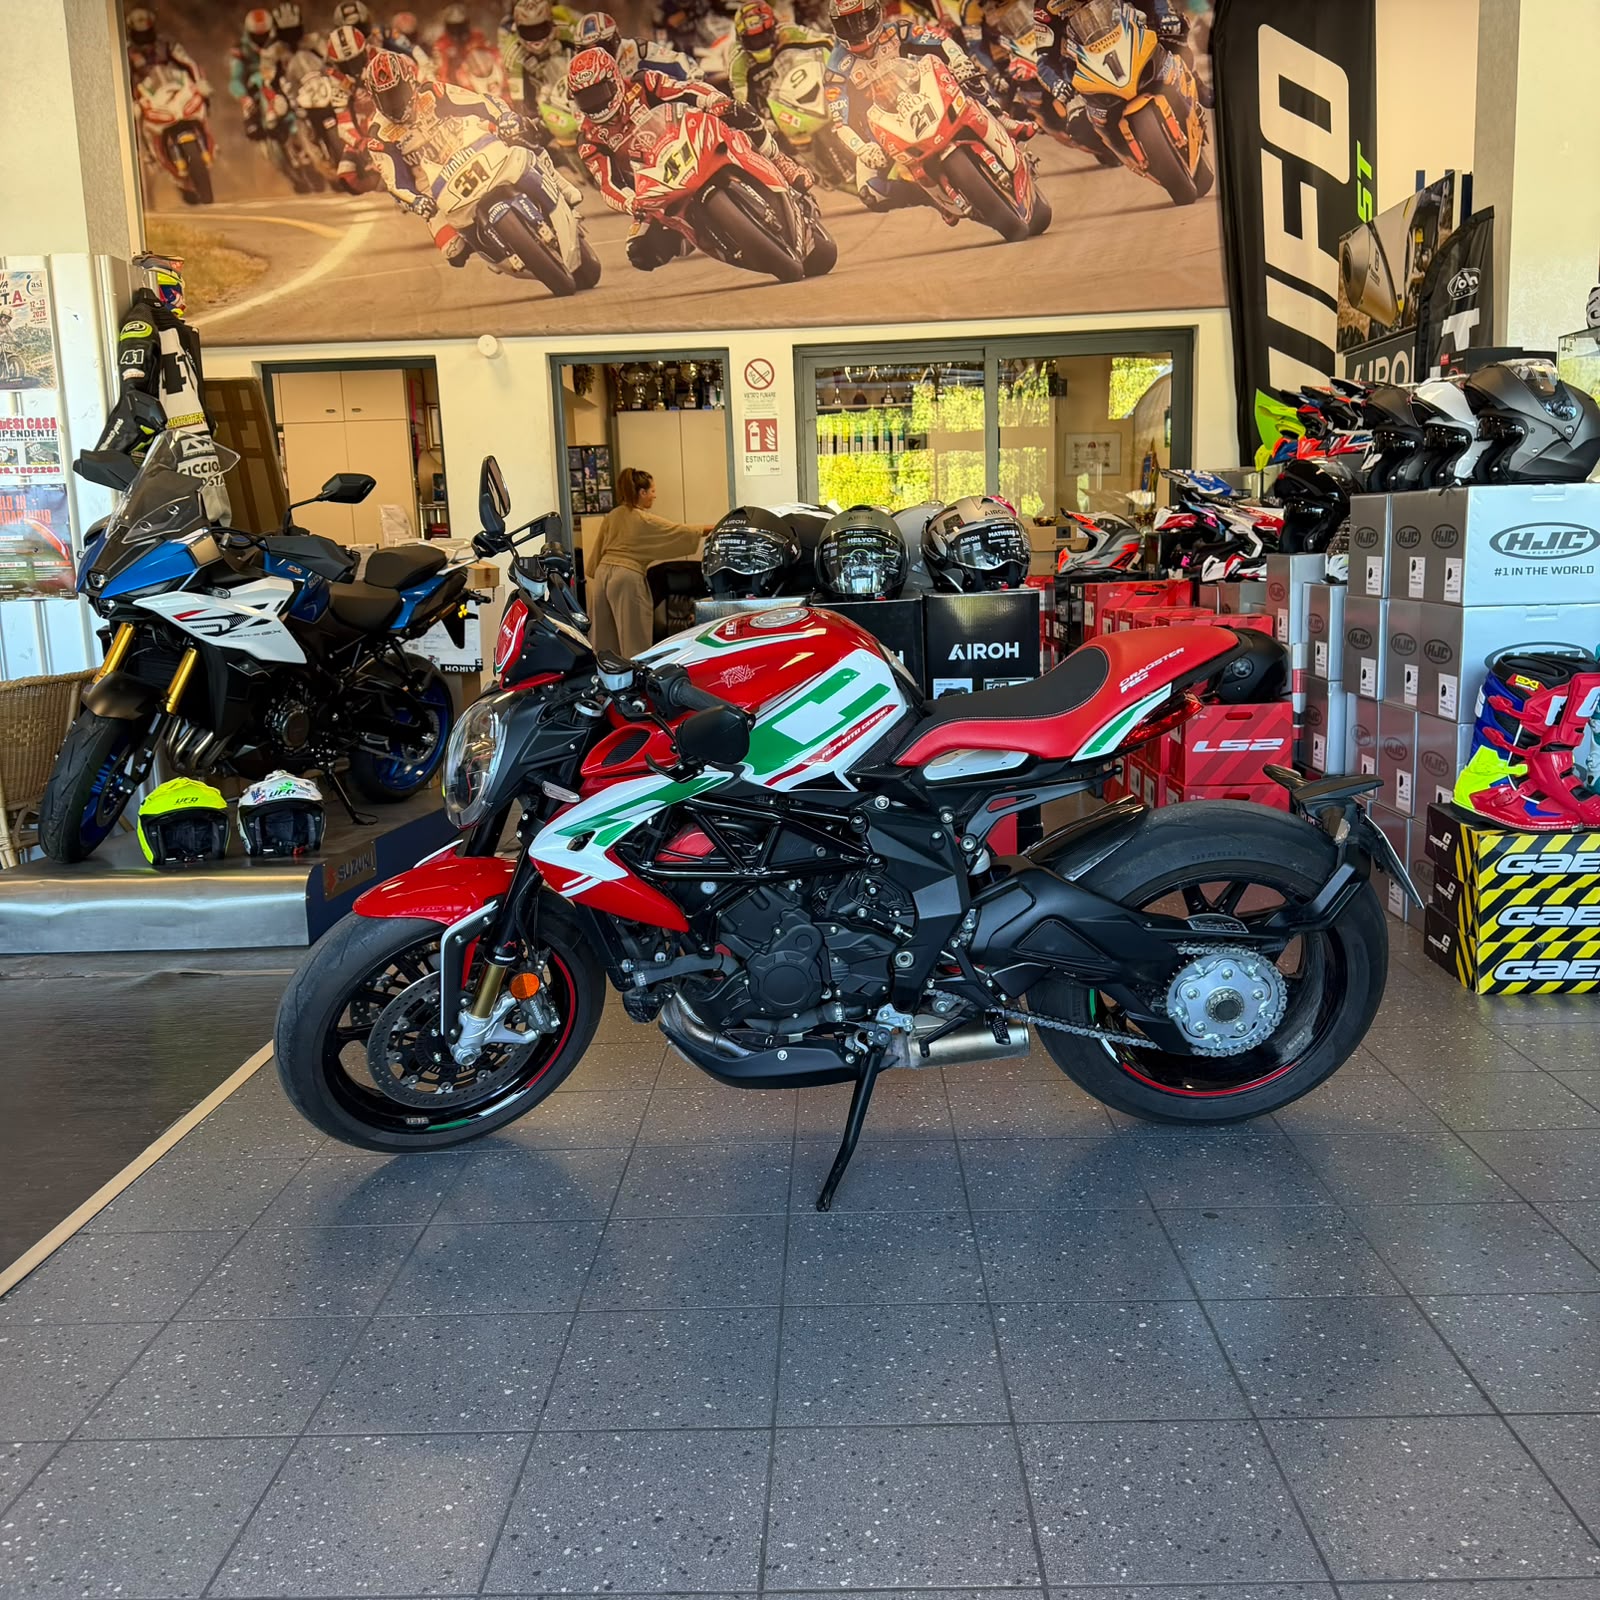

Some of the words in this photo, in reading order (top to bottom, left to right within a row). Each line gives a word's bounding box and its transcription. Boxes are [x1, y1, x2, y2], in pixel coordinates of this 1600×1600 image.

[1102, 49, 1126, 82] 1
[910, 102, 939, 140] 21
[663, 141, 693, 184] 41
[454, 160, 491, 198] 31
[120, 349, 145, 365] 41
[745, 455, 779, 463] ESTINTORE
[1504, 531, 1589, 551] HJC
[1494, 567, 1509, 577] #1
[1511, 567, 1524, 576] IN
[1524, 566, 1548, 576] THE
[1551, 565, 1595, 575] WORLD
[948, 642, 1020, 661] AIROH
[1119, 647, 1185, 688] DRAGSTER
[1192, 738, 1285, 753] LS2
[337, 851, 375, 881] SUZUKI
